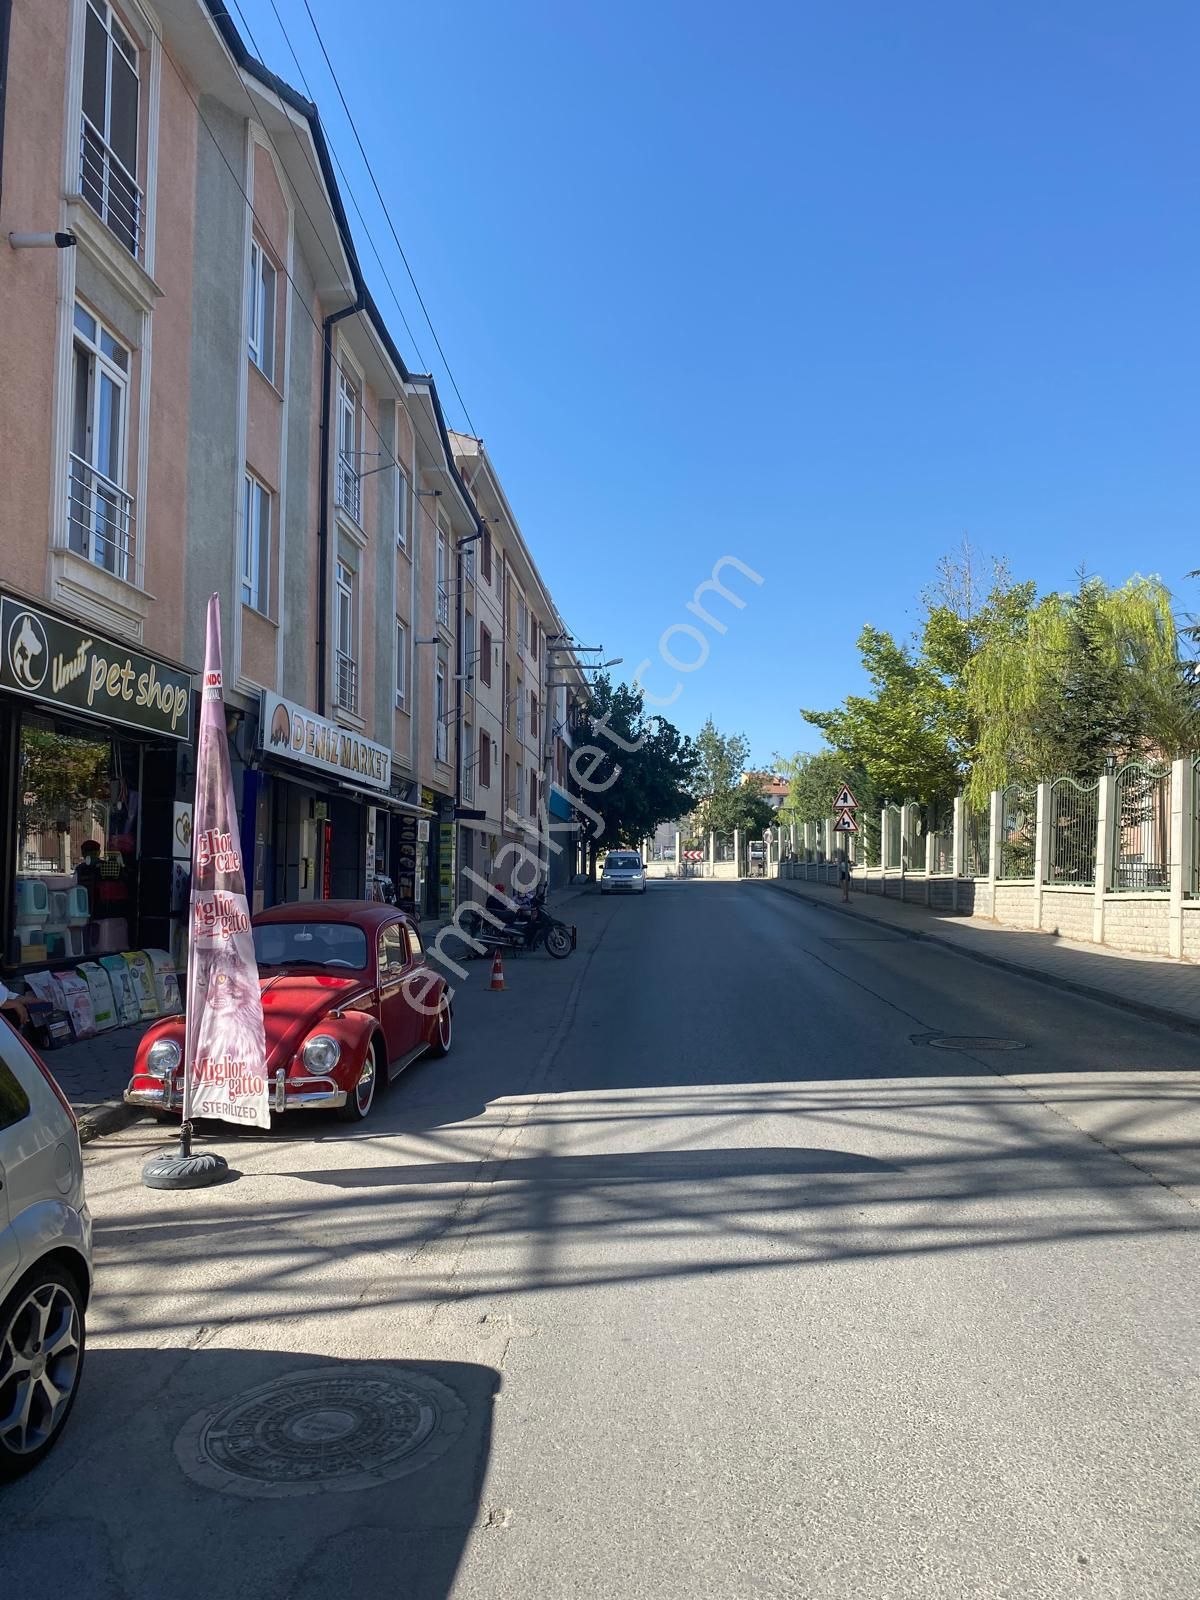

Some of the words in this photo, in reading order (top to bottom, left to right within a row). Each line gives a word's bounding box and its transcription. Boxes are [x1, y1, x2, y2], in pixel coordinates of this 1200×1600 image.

[88, 654, 135, 706] pet
[136, 664, 187, 730] shop
[341, 735, 389, 782] MARKET
[221, 908, 248, 939] gatto
[192, 1055, 246, 1087] Miglior
[228, 1072, 264, 1103] gatto
[202, 1100, 257, 1119] STERILIZED
